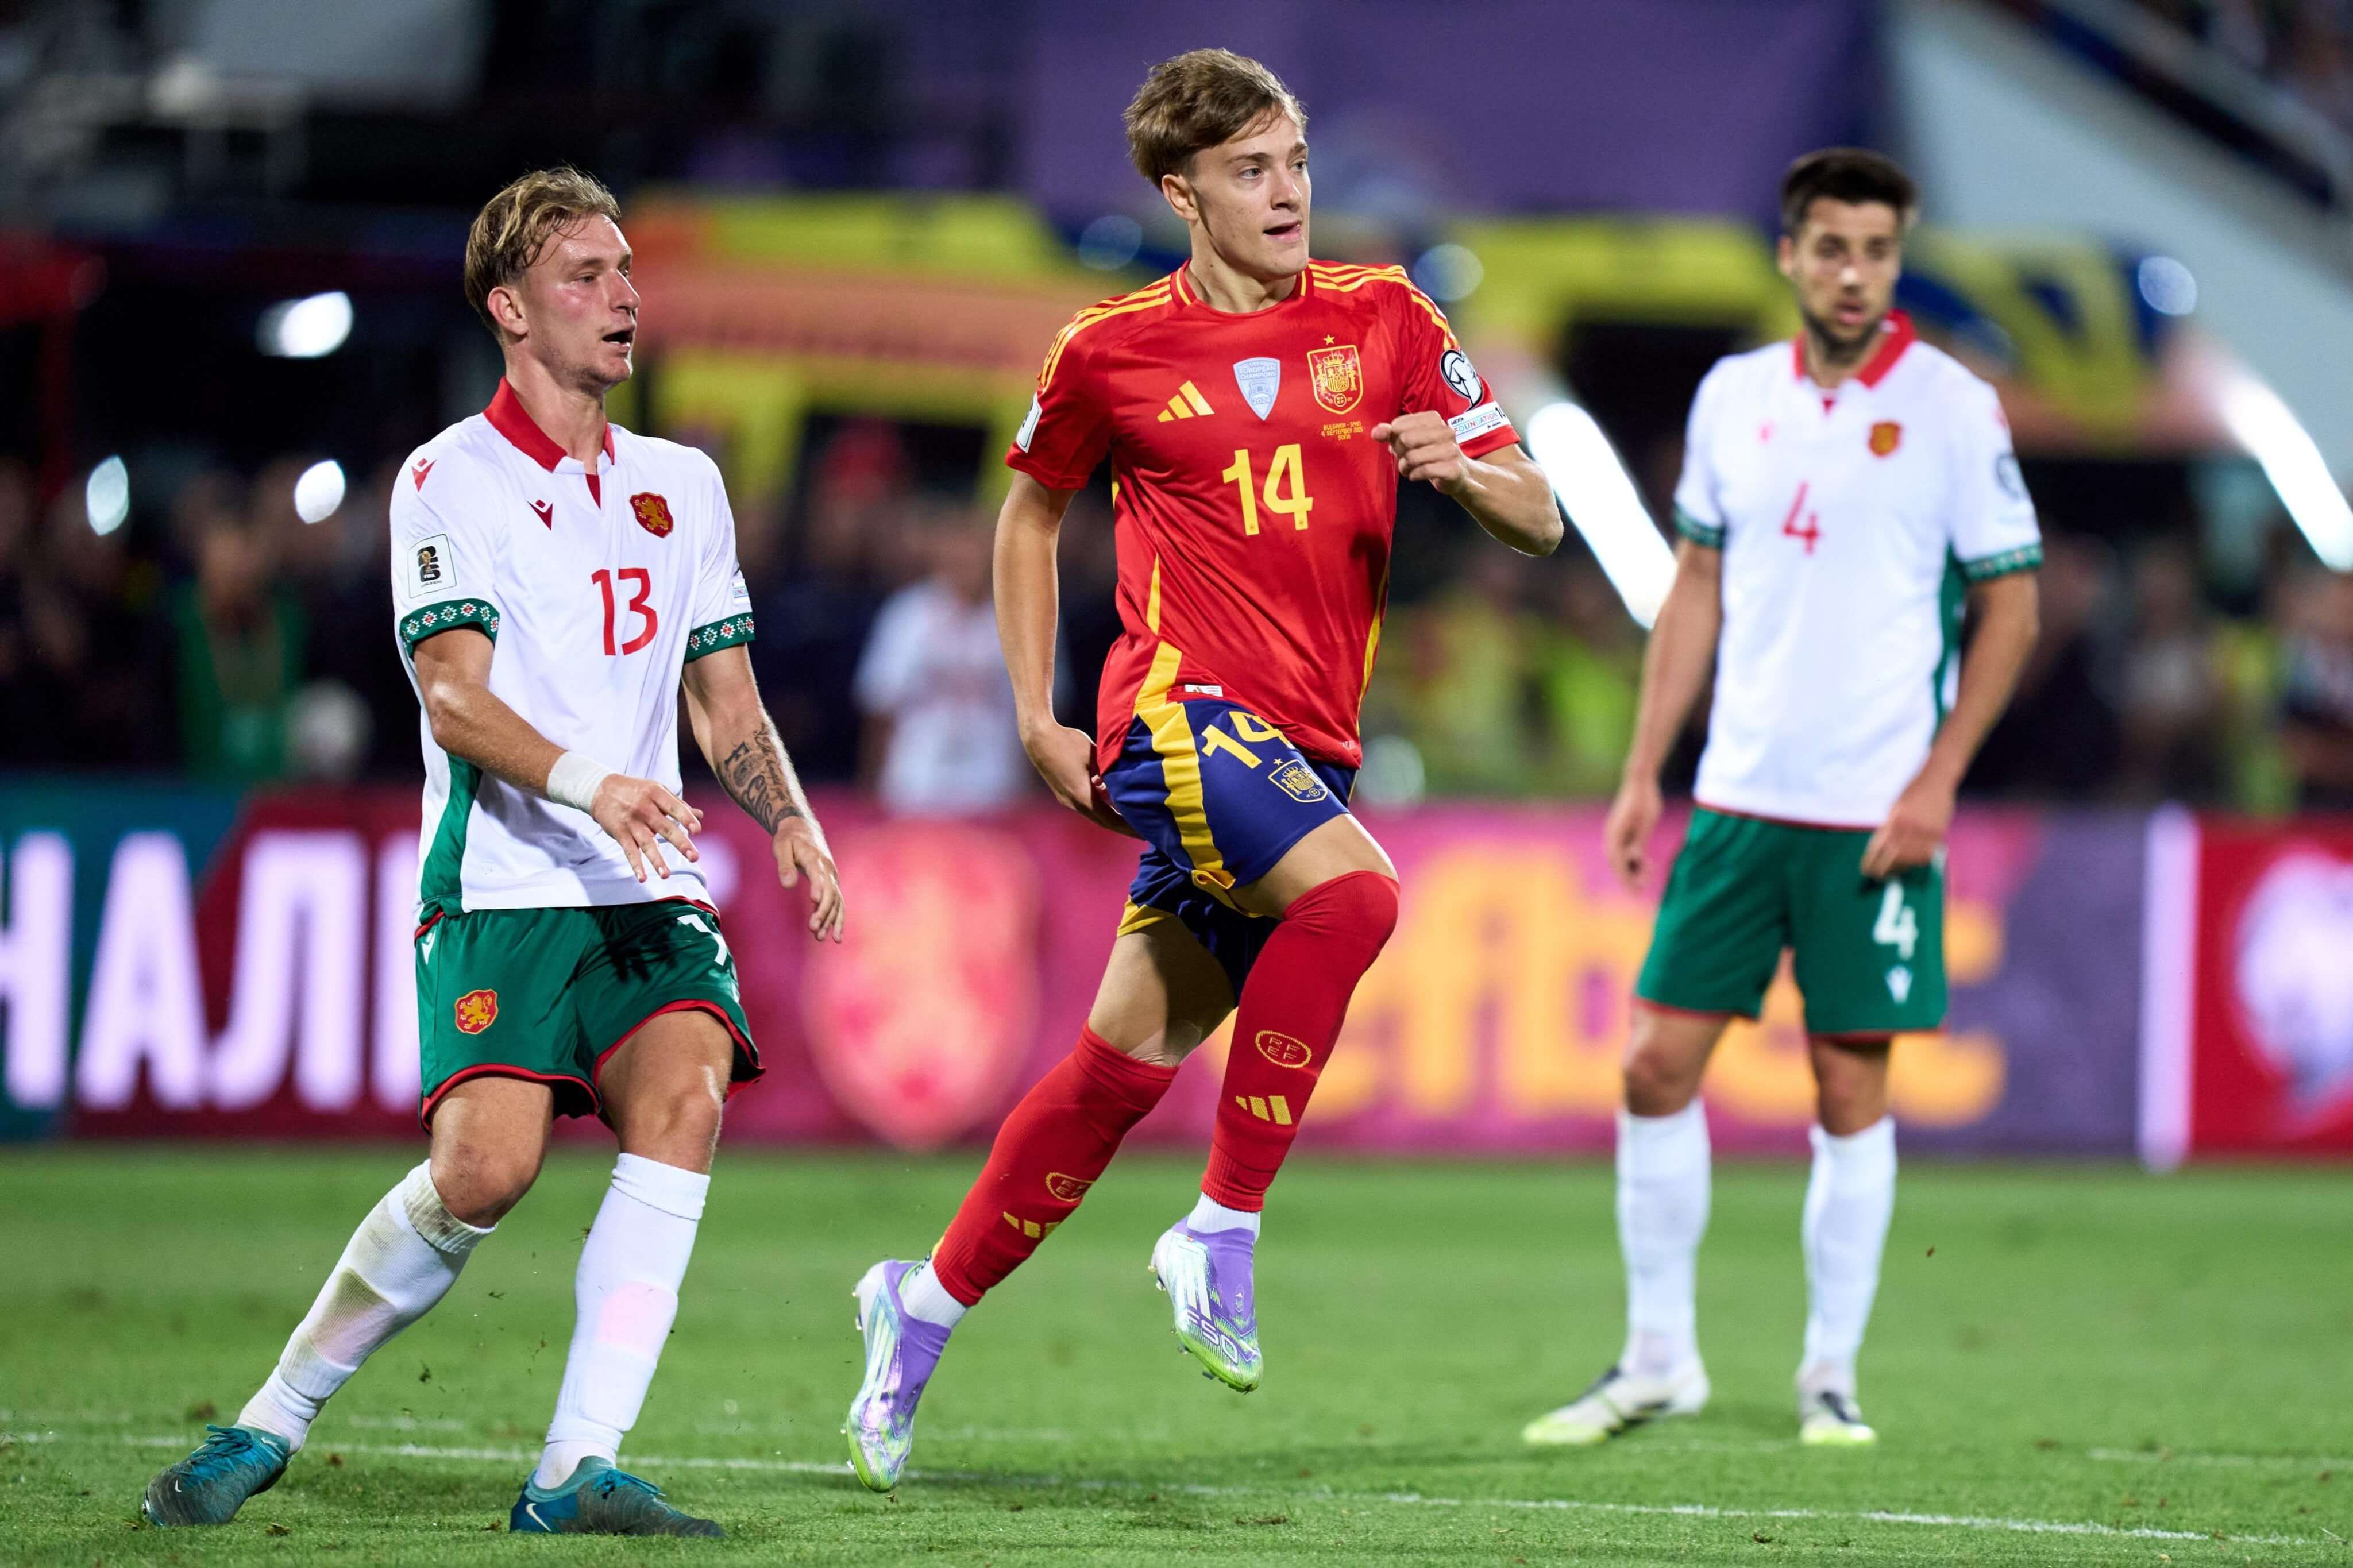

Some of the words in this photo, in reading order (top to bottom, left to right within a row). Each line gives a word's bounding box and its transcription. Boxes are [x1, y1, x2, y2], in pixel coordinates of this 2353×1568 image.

[1239, 365, 1275, 374] EUROPEAN
[1240, 371, 1276, 380] CHAMPIONS
[1252, 396, 1271, 404] 2024
[1222, 443, 1313, 536] 14
[1782, 481, 1821, 555] 4
[591, 567, 658, 656] 13
[1201, 710, 1297, 770] 14
[1872, 880, 1919, 961] 4
